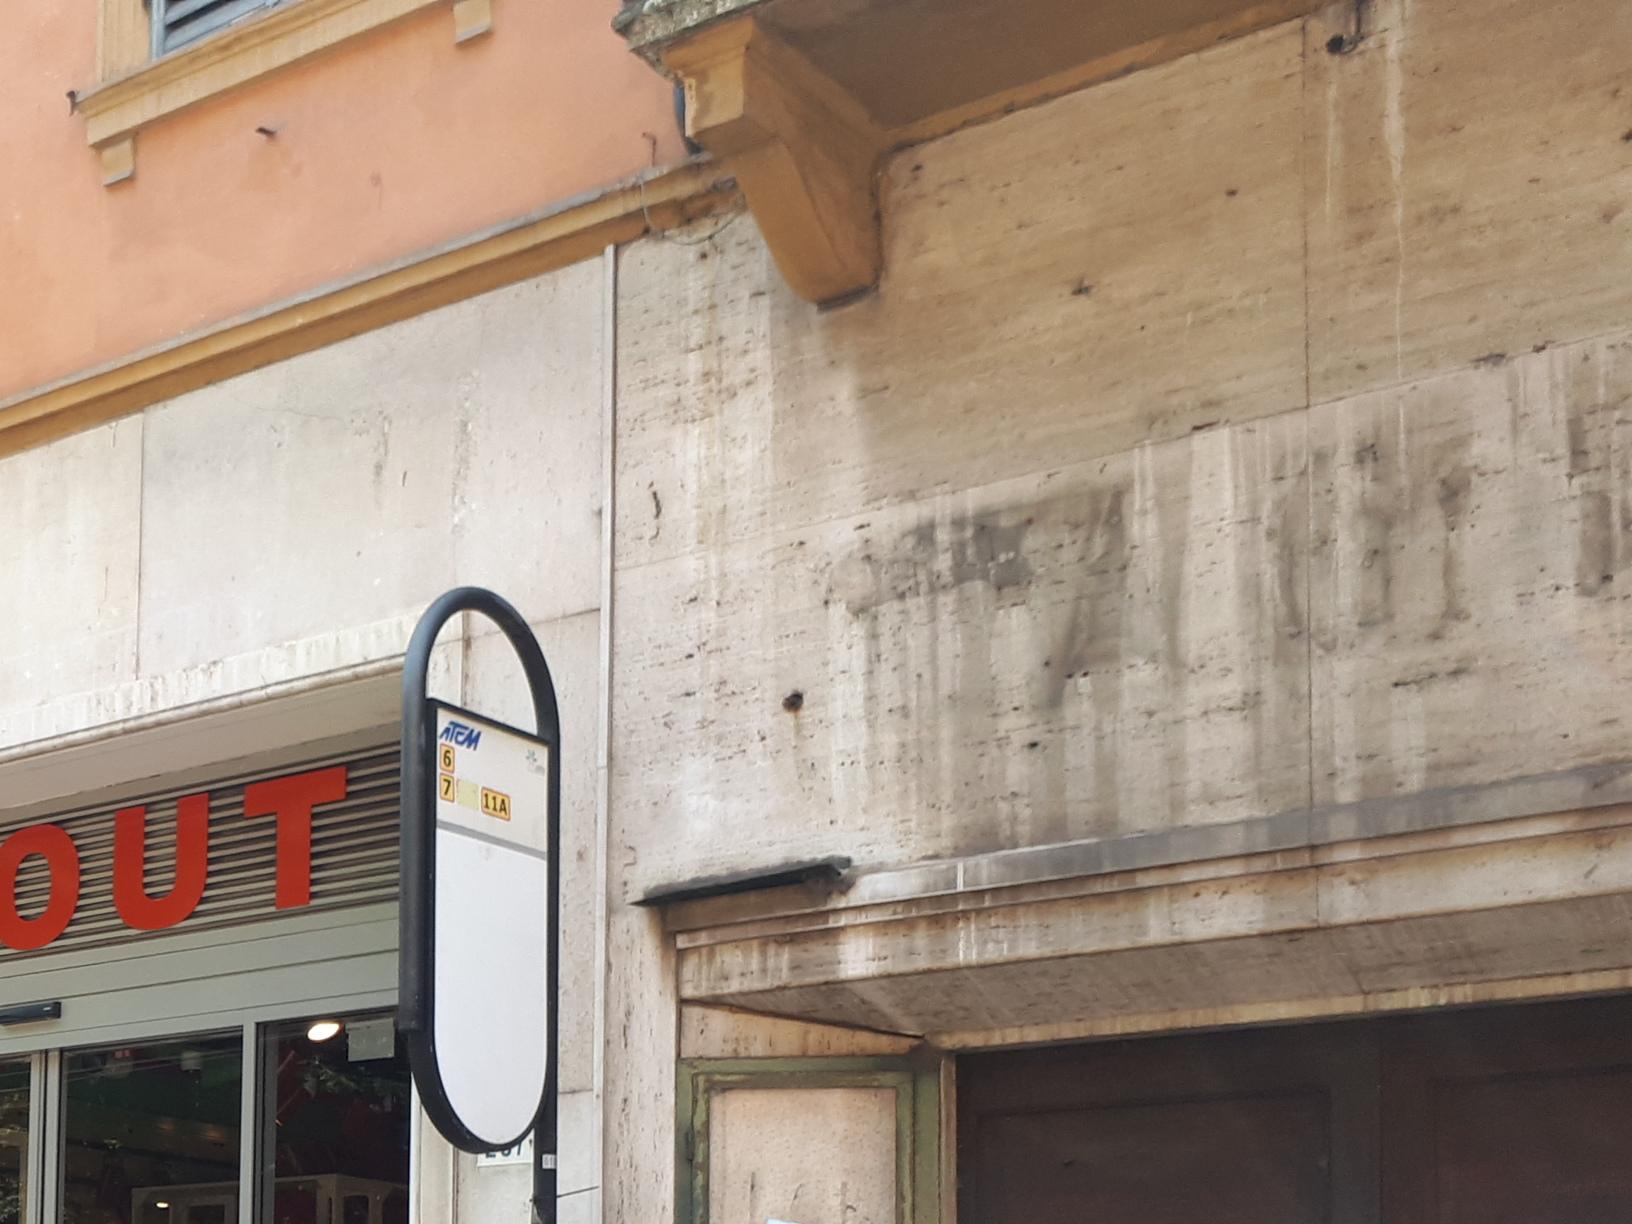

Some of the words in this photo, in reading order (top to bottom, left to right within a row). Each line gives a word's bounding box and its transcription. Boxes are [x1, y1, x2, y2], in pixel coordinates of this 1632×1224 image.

[443, 749, 452, 768] 6
[442, 778, 451, 796] 7
[484, 792, 508, 816] 11A
